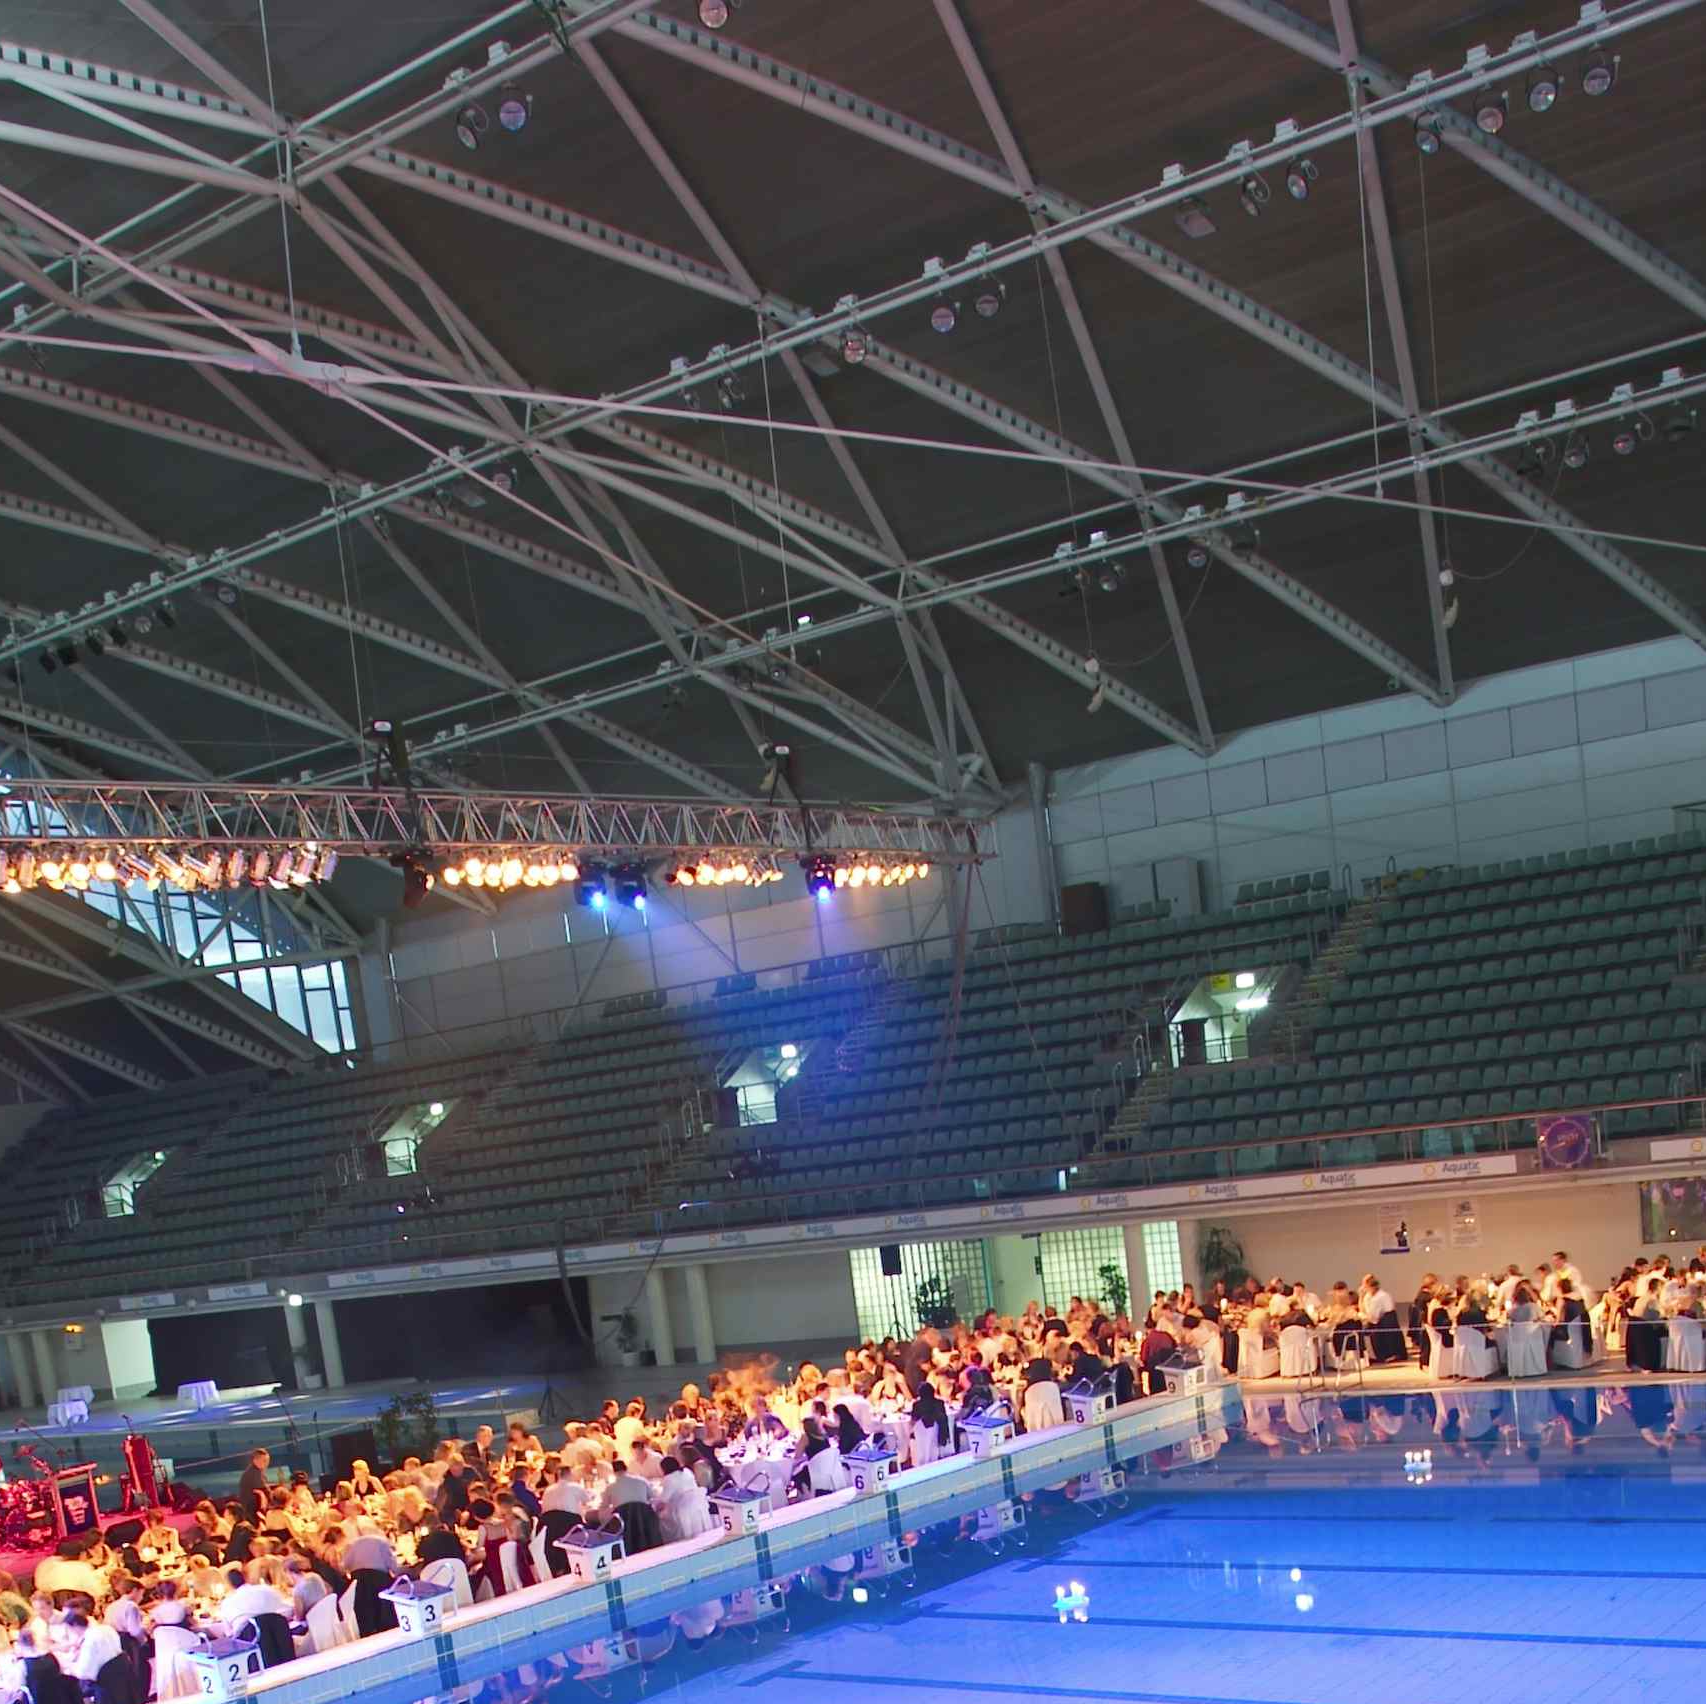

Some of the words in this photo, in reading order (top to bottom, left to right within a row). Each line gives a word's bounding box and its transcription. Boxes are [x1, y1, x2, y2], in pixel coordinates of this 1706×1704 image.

[1442, 1160, 1480, 1176] Aquatic
[1320, 1173, 1356, 1187] Aquatic
[1205, 1184, 1237, 1196] Aquatic
[1075, 1409, 1085, 1423] 8
[972, 1441, 980, 1453] 7
[994, 1434, 1000, 1446] 7
[877, 1466, 884, 1481] 6
[855, 1475, 864, 1490] 6
[724, 1516, 732, 1531] 5
[596, 1555, 606, 1569] 4
[574, 1563, 582, 1577] 4
[425, 1604, 436, 1622] 3
[401, 1615, 411, 1632] 3
[229, 1663, 242, 1682] 2
[203, 1676, 213, 1694] 2
